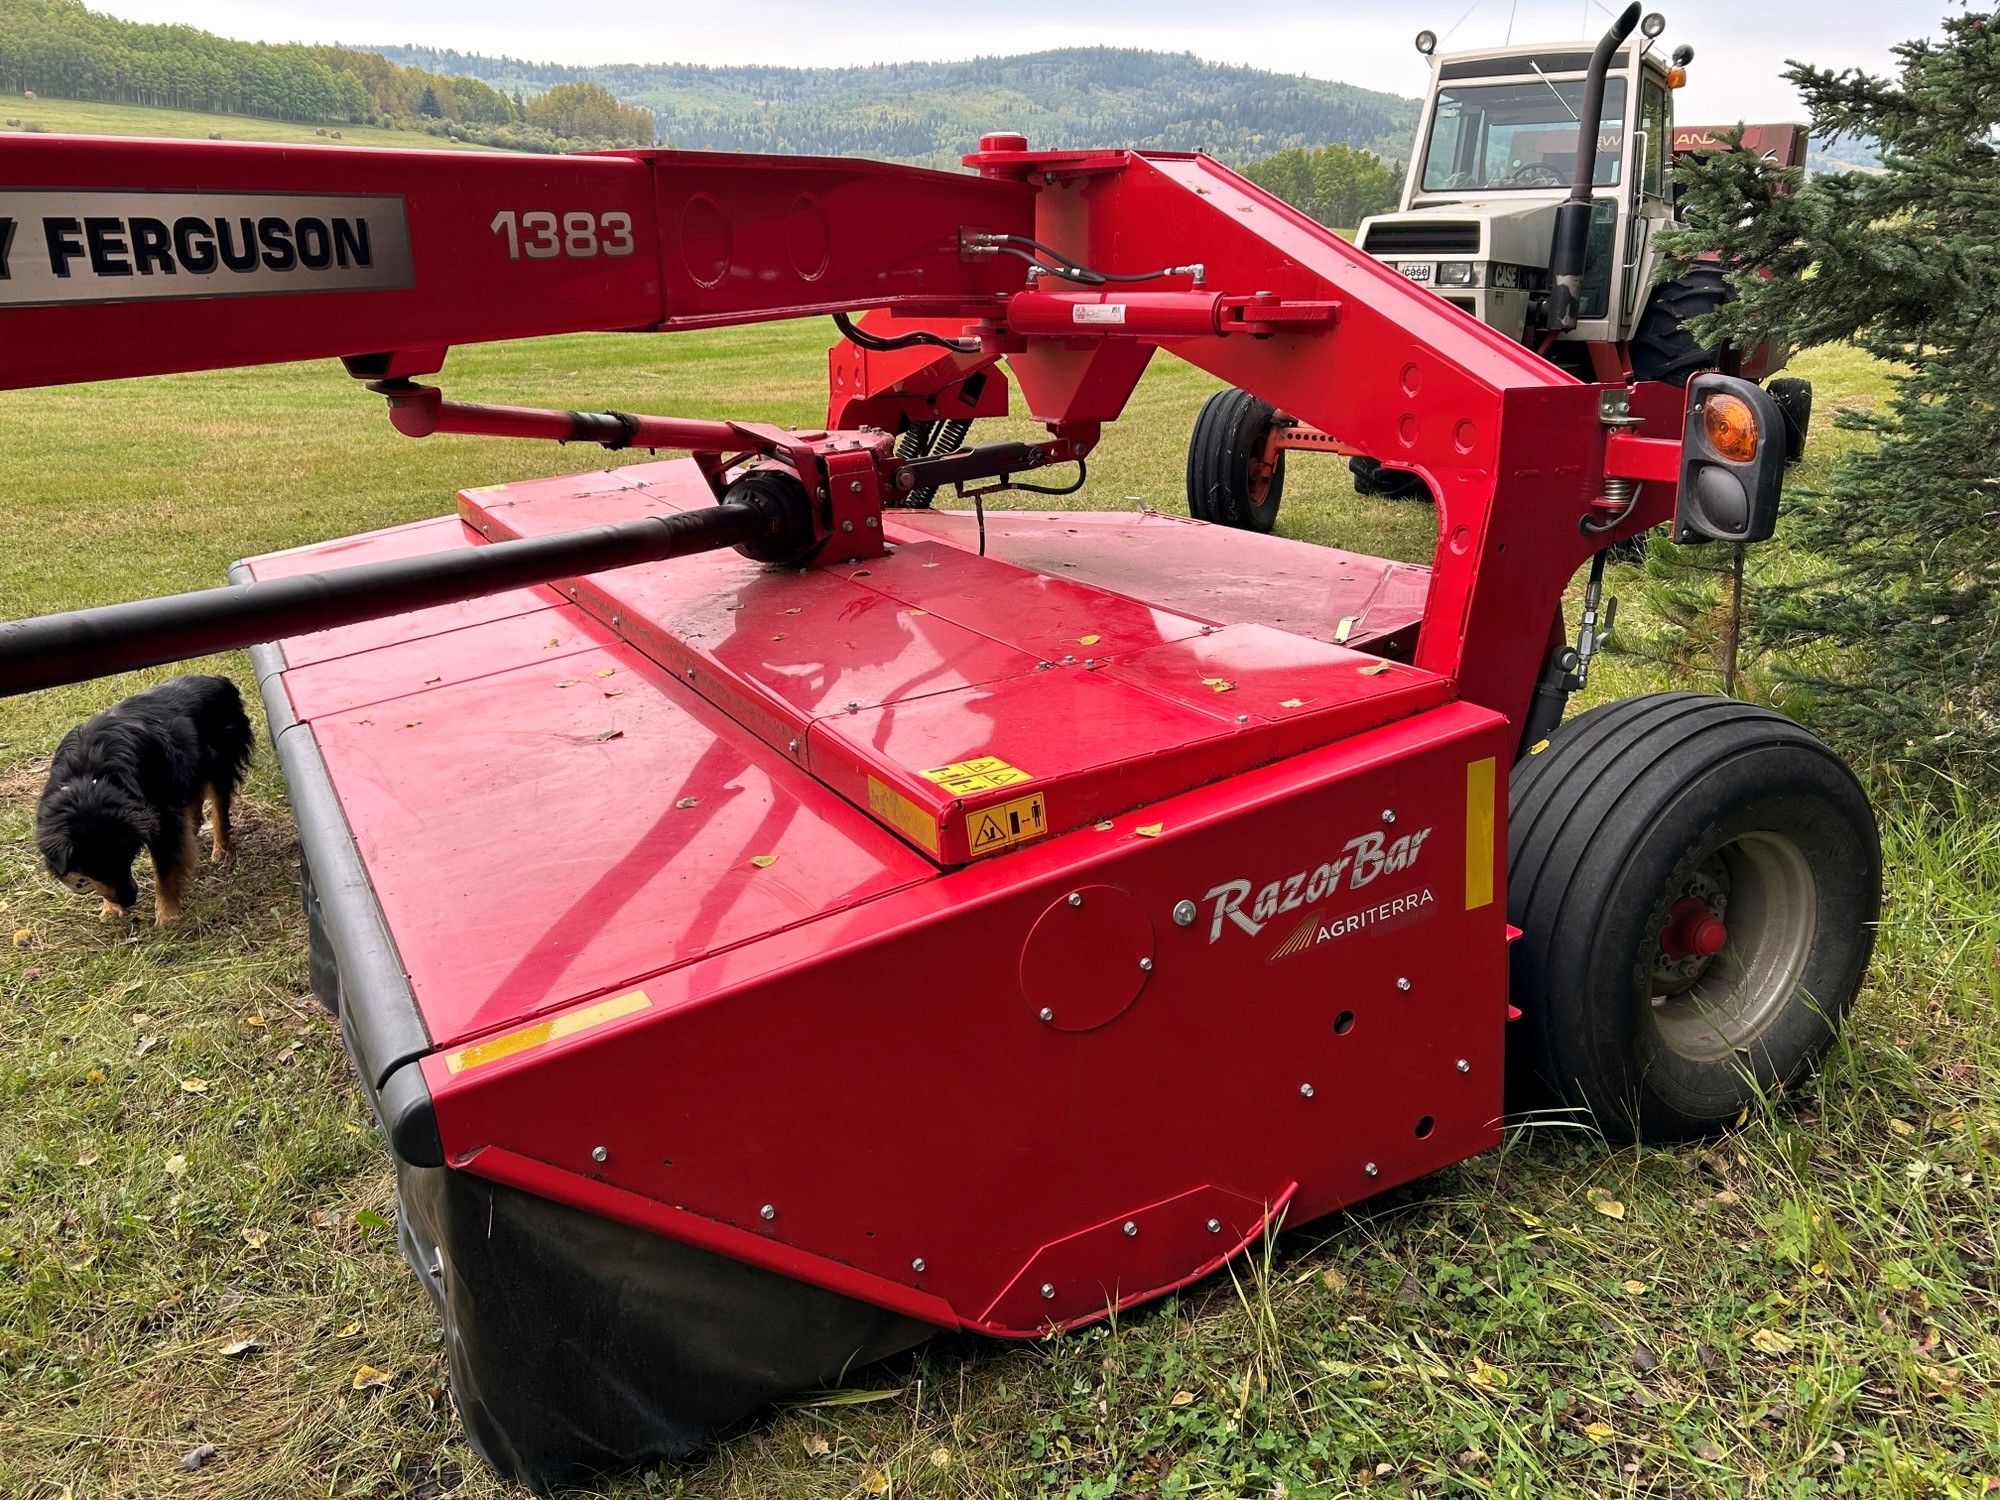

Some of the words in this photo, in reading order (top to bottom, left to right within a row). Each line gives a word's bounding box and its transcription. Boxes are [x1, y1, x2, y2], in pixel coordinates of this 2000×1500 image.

[42, 216, 374, 278] FERGUSON
[489, 208, 635, 259] 1383
[1495, 264, 1517, 287] CASE
[1202, 826, 1434, 945] RazorBar
[1316, 888, 1434, 944] AGRITERRA
